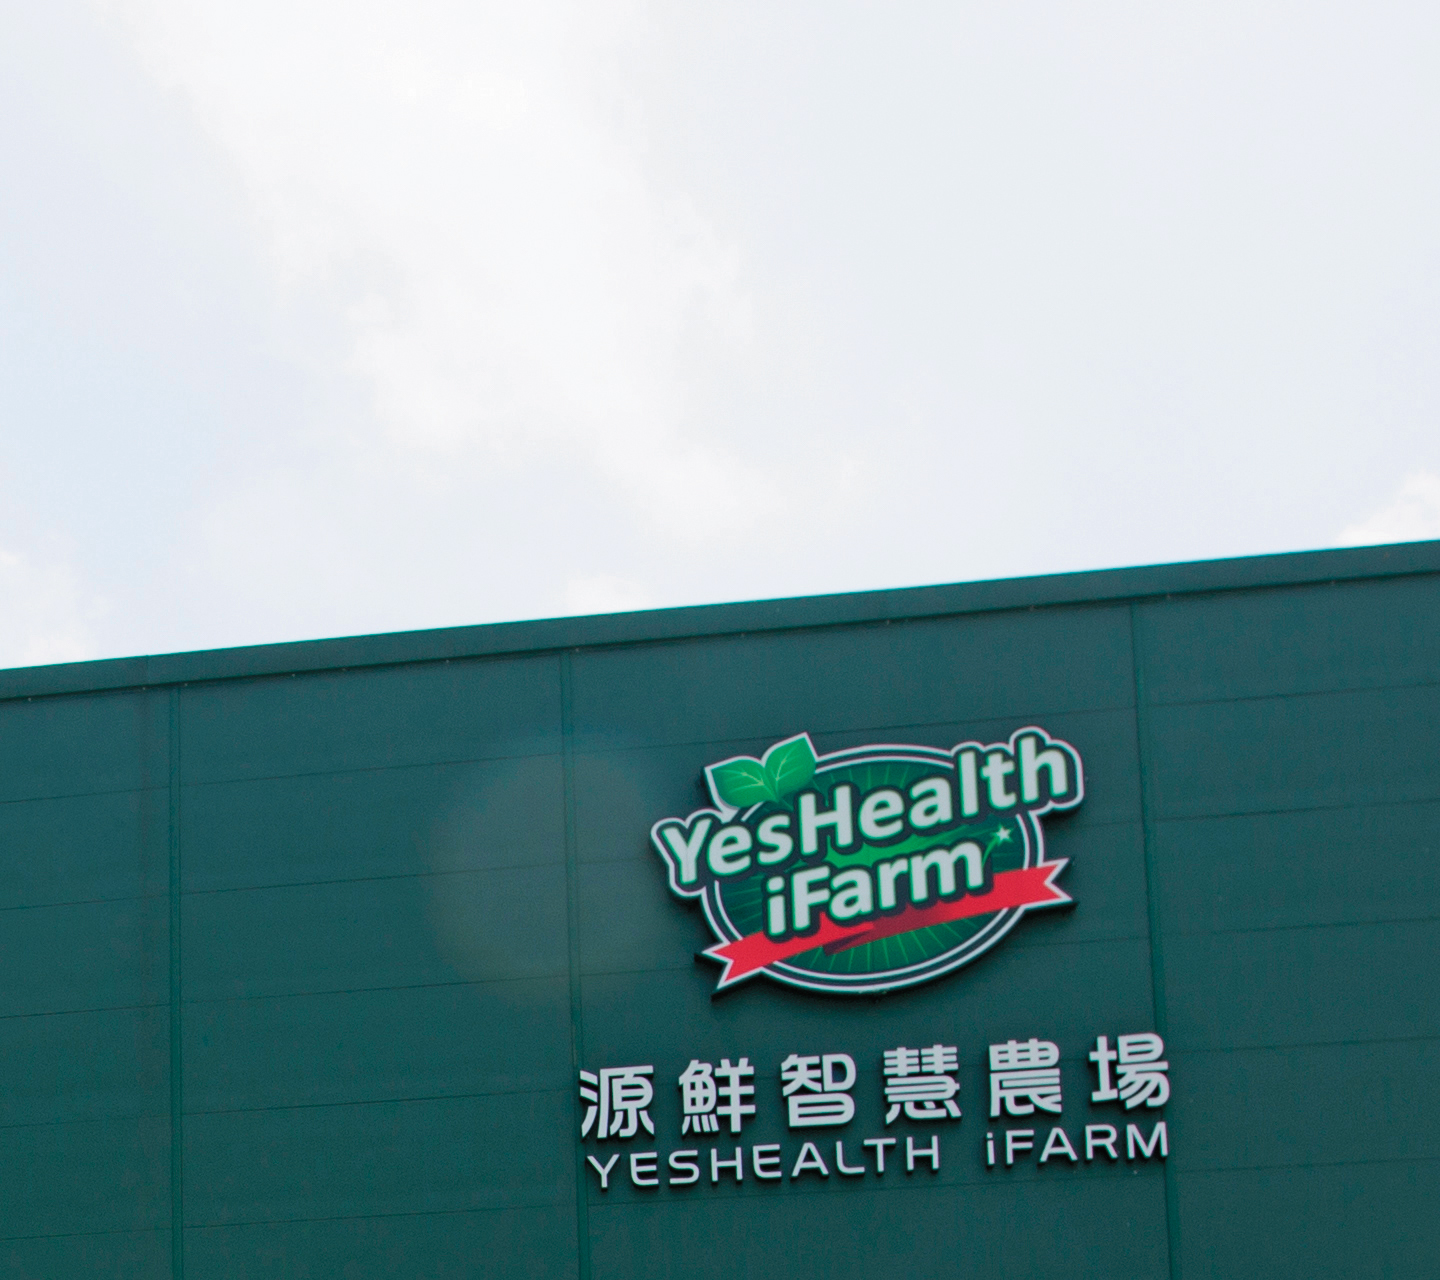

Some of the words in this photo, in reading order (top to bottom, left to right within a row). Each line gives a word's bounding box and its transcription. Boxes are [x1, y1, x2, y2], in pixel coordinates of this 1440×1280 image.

[663, 735, 1070, 886] YesHealth
[764, 838, 986, 938] iFarm
[579, 1032, 1171, 1141] 源鮮智慧農場
[587, 1135, 942, 1190] YESHEALTH
[985, 1121, 1170, 1167] iFARM
